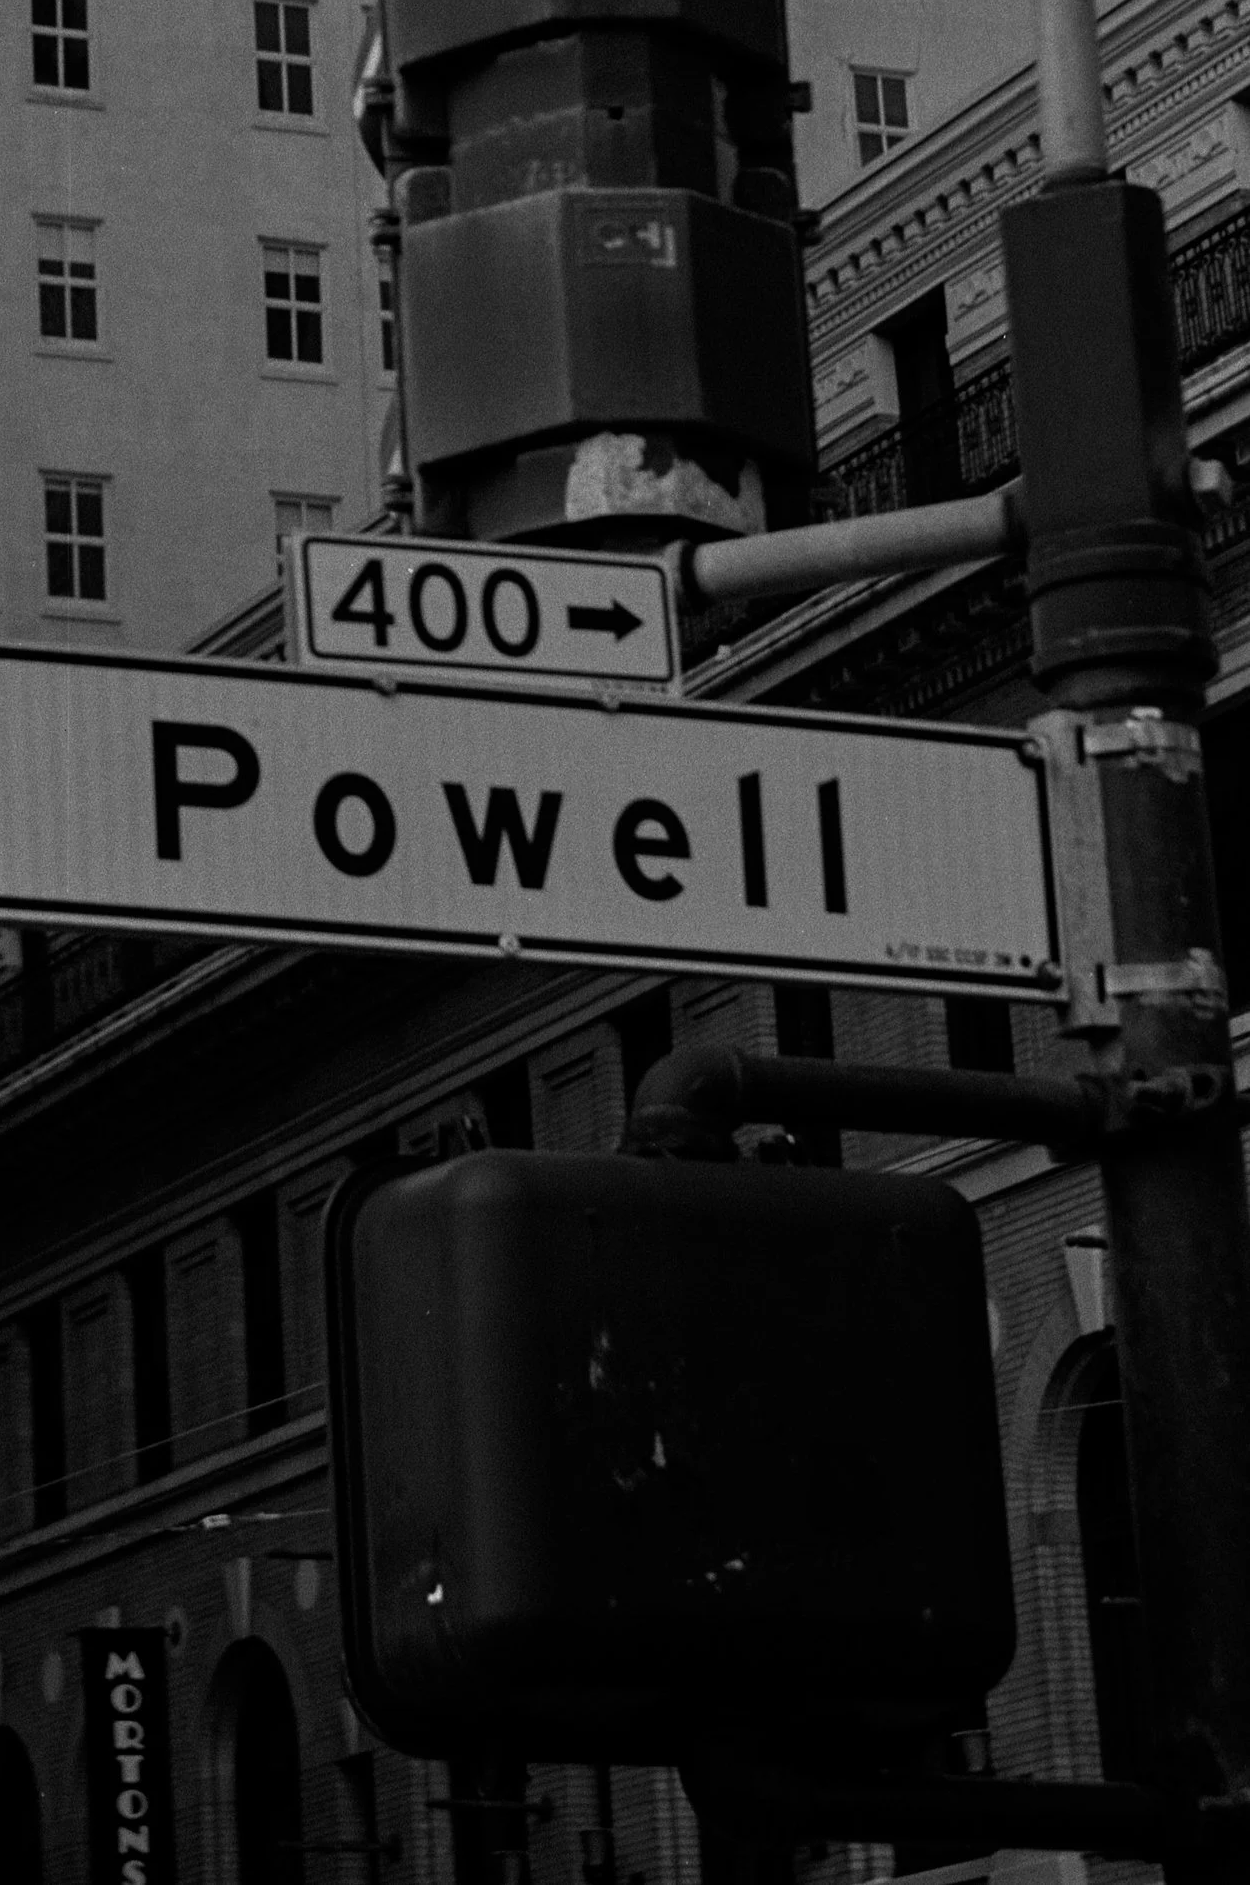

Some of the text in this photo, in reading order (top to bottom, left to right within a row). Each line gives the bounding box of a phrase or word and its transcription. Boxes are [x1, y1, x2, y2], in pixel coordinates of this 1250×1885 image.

[330, 557, 542, 660] 400
[150, 718, 848, 916] Powell
[104, 1651, 150, 1885] MORTONS
